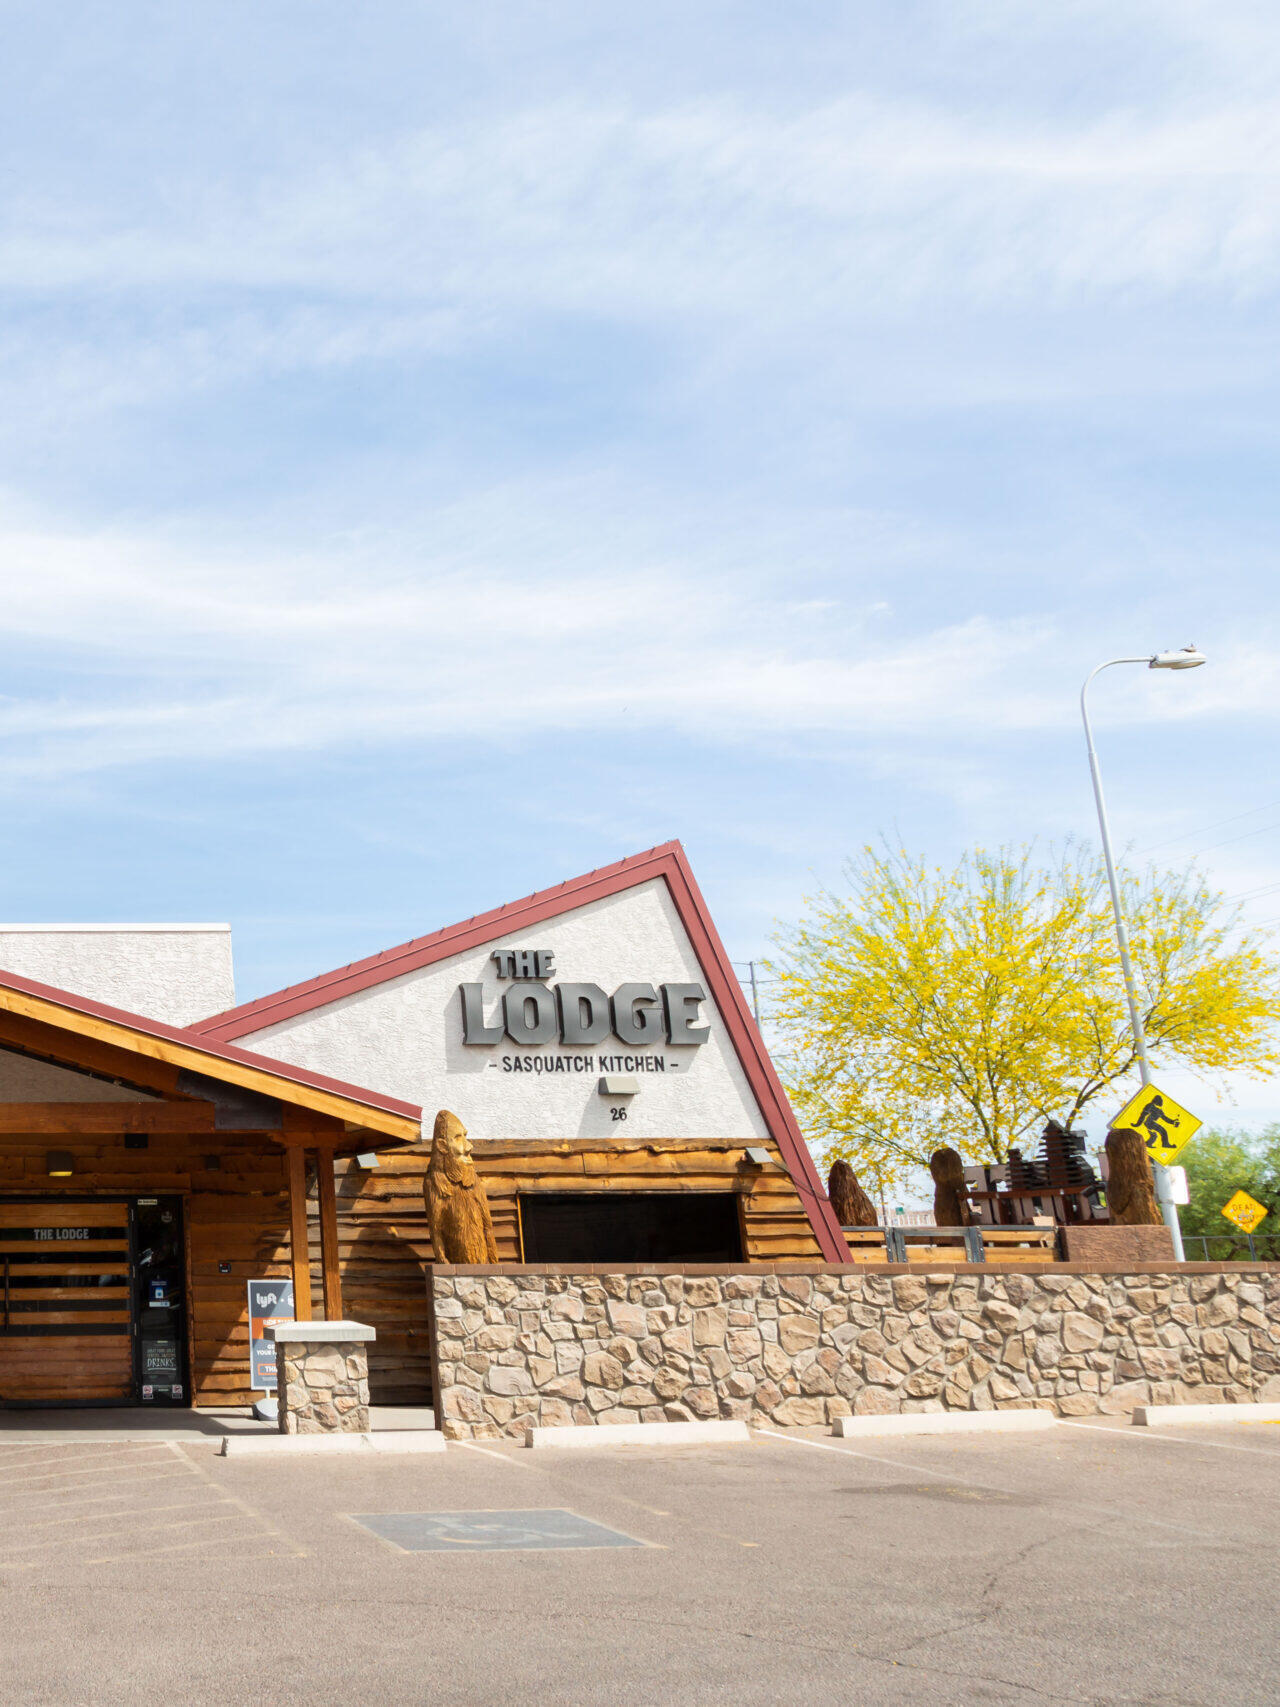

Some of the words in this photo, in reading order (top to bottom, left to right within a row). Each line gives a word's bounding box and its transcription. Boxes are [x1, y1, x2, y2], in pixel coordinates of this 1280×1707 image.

[490, 950, 556, 978] THE
[458, 983, 711, 1045] LODGE
[503, 1056, 594, 1075] SASQUATCH
[599, 1056, 665, 1072] KITCHEN
[610, 1107, 627, 1121] 26
[34, 1228, 54, 1240] THE
[56, 1228, 89, 1240] LODGE
